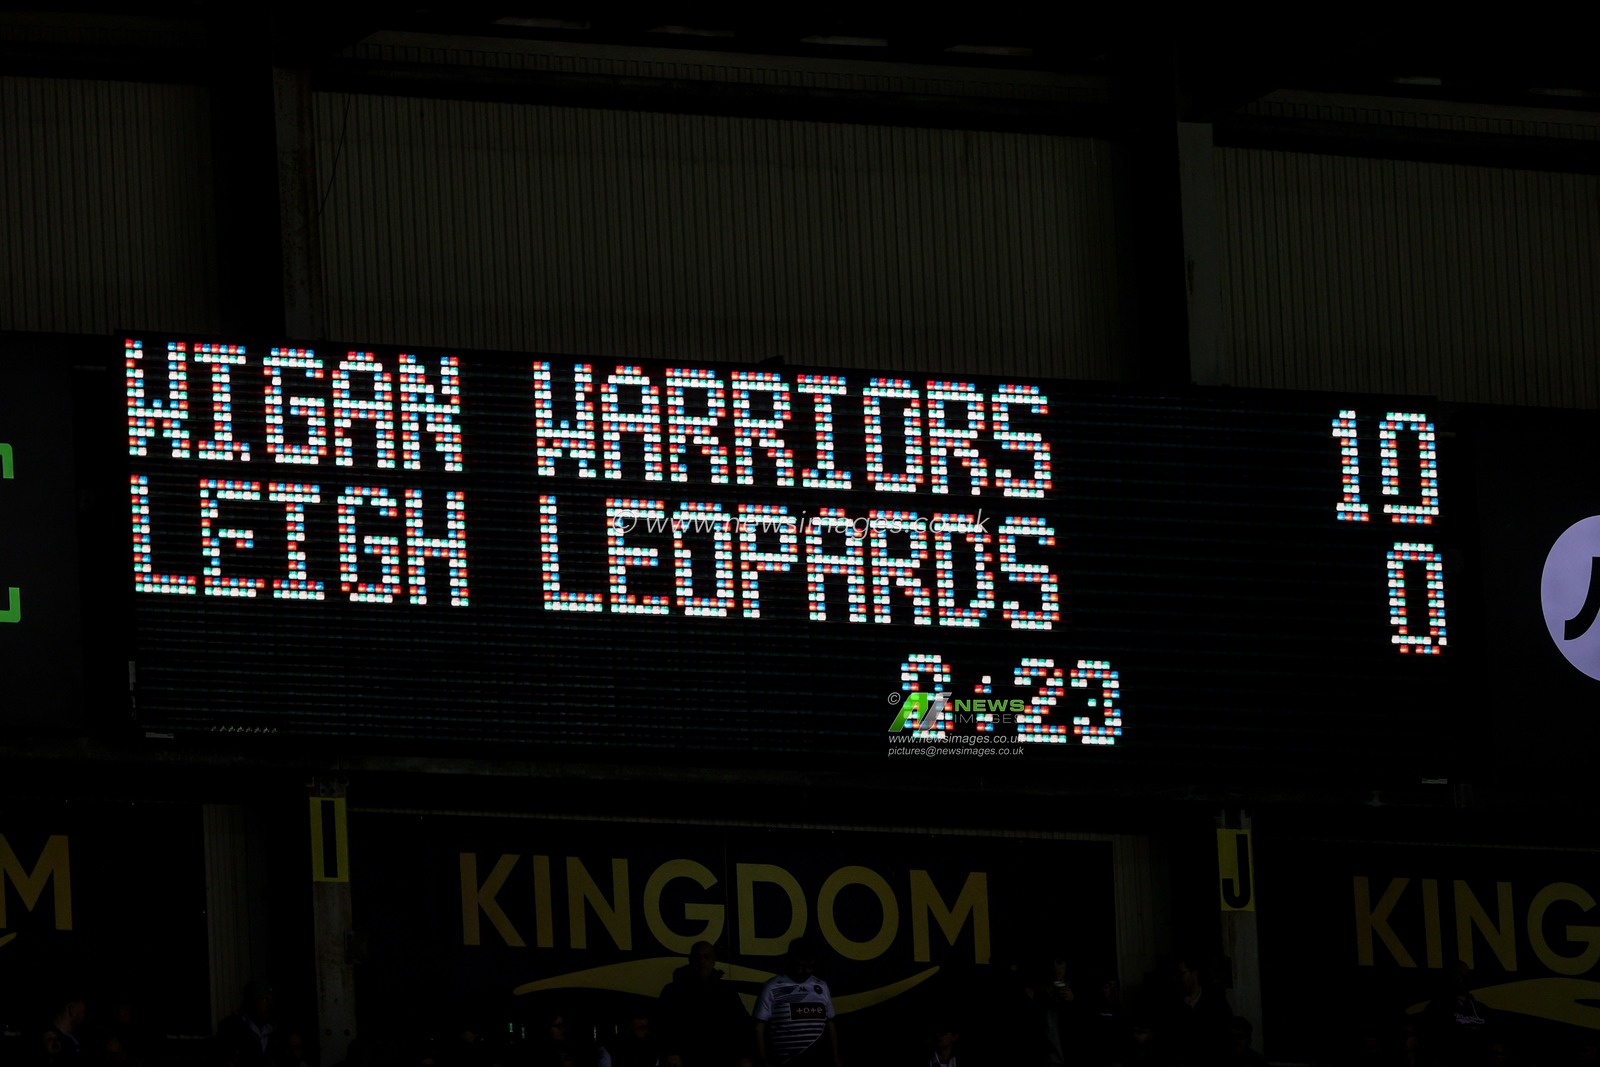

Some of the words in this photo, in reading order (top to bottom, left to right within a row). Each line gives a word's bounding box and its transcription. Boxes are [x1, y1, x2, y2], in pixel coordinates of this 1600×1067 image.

[125, 338, 463, 472] WIGAN
[533, 360, 1052, 500] WARRIORS
[1332, 409, 1440, 524] 10
[130, 474, 469, 607] LEIGH
[539, 494, 1061, 631] LEOPARDS
[1386, 541, 1448, 655] 0
[458, 851, 992, 966] KINGDOM
[1221, 833, 1252, 909] J
